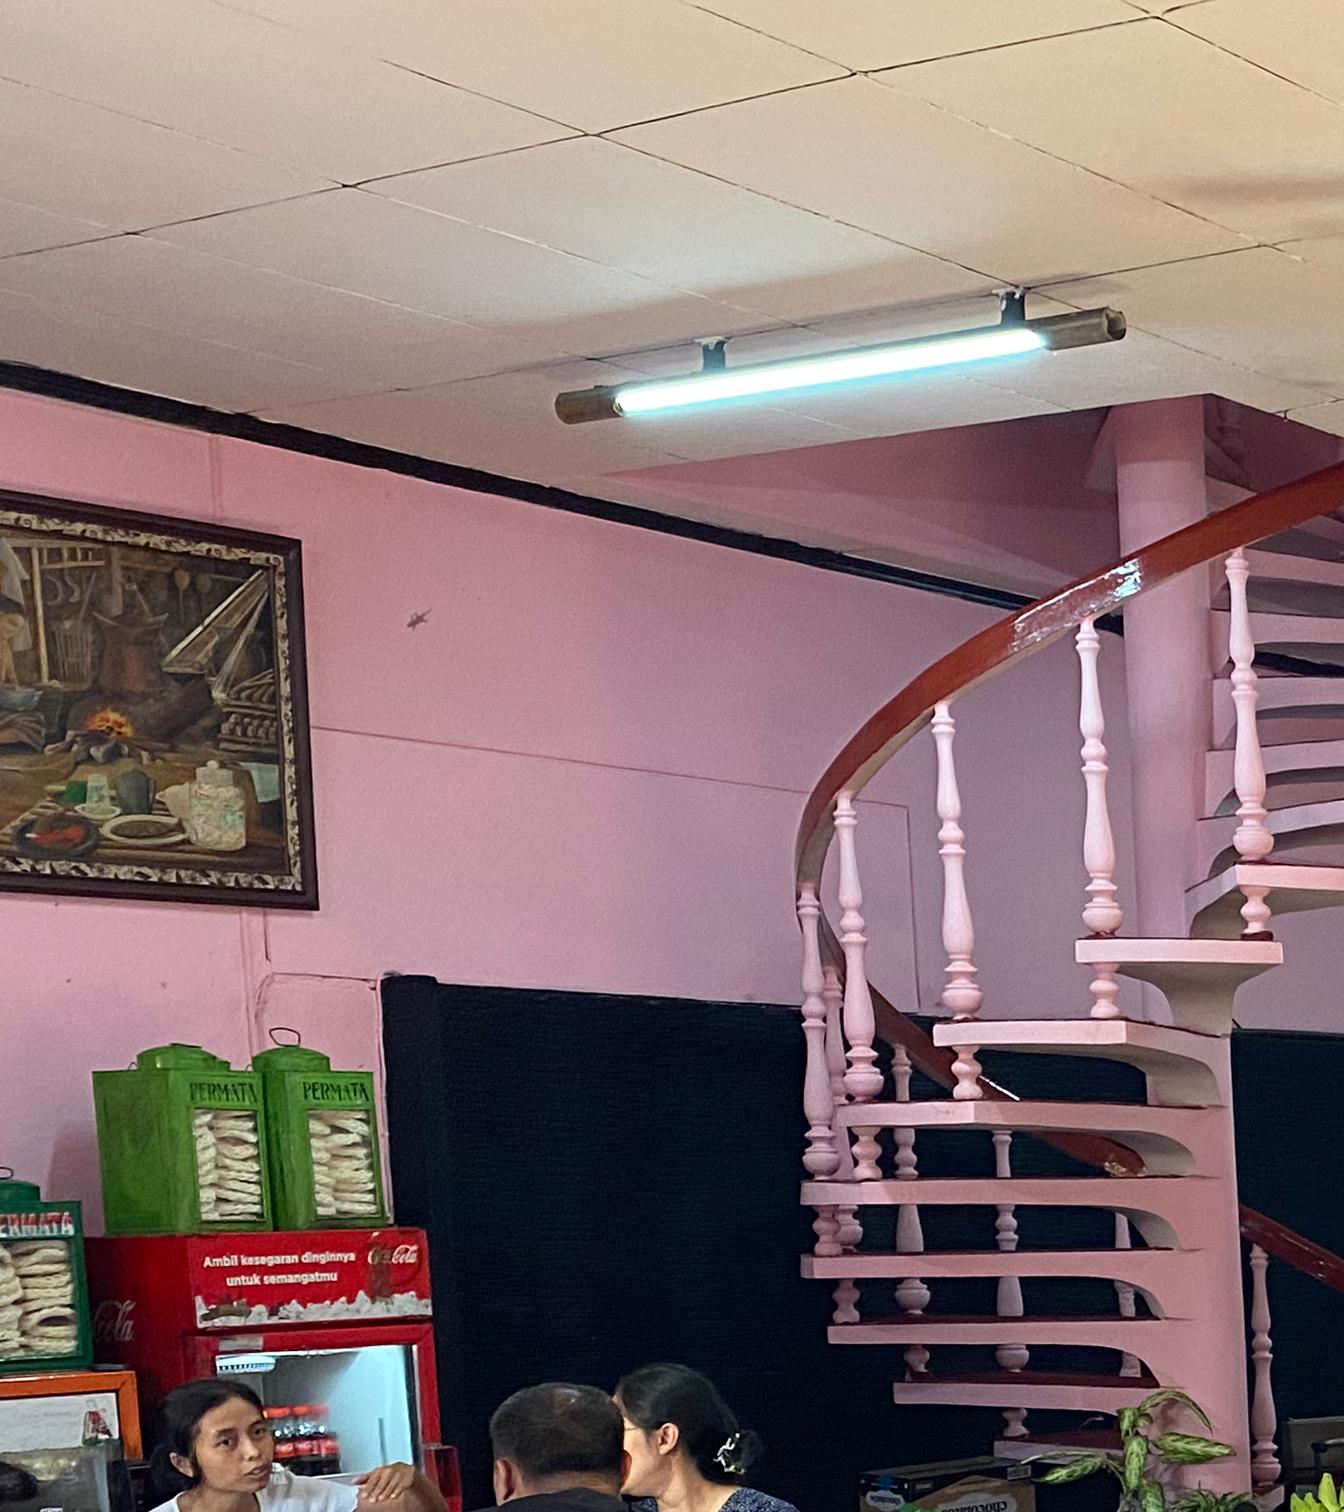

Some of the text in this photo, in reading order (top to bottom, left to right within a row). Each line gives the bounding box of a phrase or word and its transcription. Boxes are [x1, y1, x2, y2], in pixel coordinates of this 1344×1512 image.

[189, 1081, 257, 1103] PERMATA
[302, 1081, 370, 1102] PERMATA
[203, 1250, 356, 1268] Ambil kesegaran dinginnya
[226, 1271, 338, 1287] untuk semangatmu
